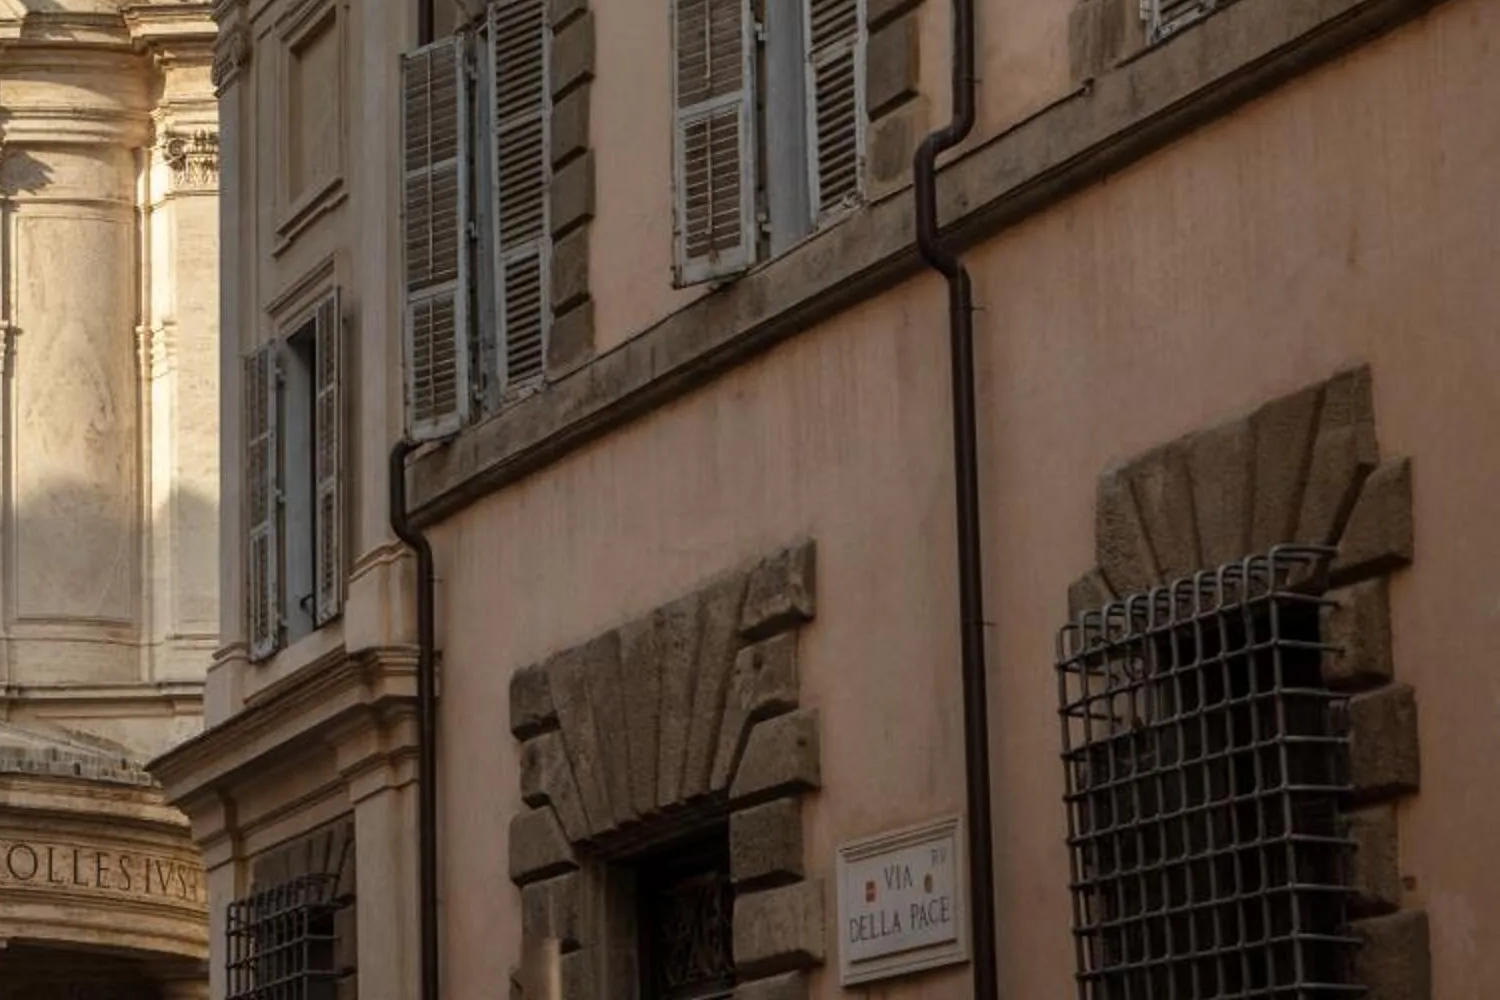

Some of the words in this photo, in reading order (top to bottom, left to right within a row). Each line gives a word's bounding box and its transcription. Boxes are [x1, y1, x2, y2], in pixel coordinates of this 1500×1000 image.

[884, 863, 914, 891] VIA
[849, 909, 902, 944] DELLA
[910, 896, 950, 931] PACE
